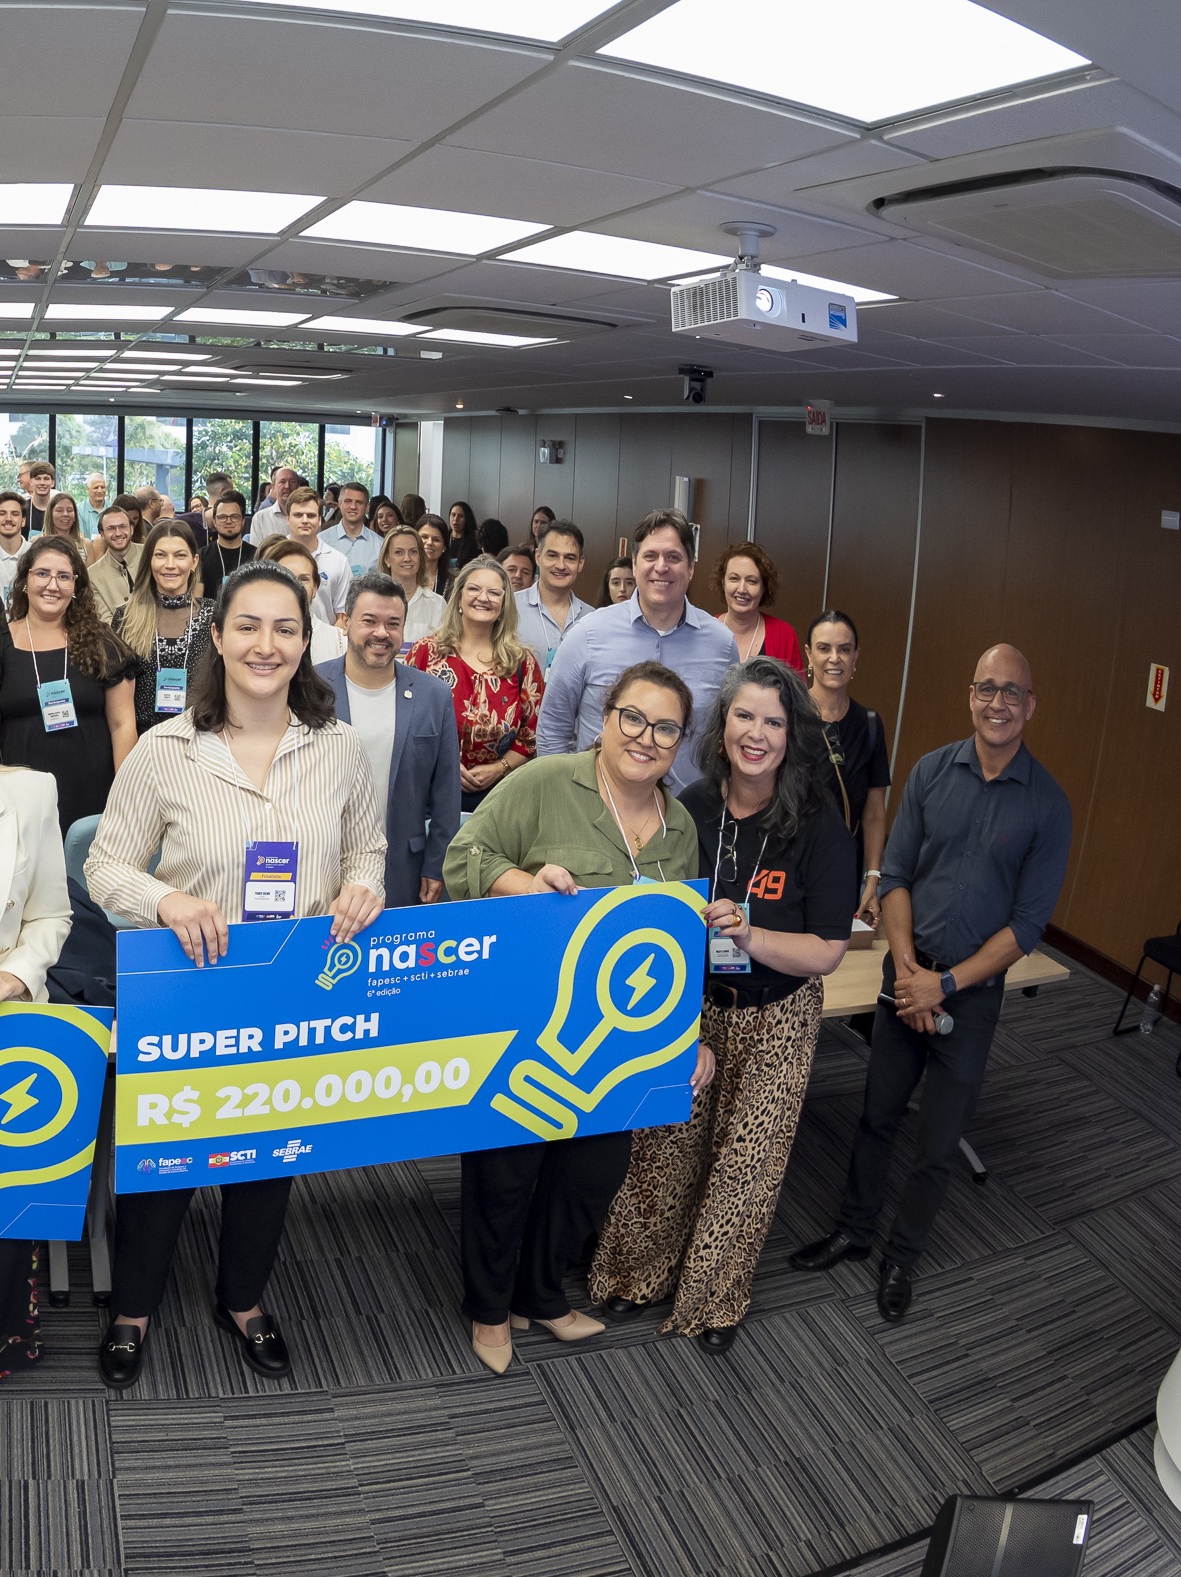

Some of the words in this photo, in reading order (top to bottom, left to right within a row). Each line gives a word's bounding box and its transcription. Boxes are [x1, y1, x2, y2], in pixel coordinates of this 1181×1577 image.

[747, 870, 786, 900] 49
[371, 930, 435, 946] programa
[369, 934, 497, 972] nascer
[367, 976, 401, 988] fapesc
[410, 971, 428, 981] scti
[437, 968, 469, 978] sebrae
[376, 987, 401, 997] edição
[137, 1027, 263, 1063] SUPER
[274, 1012, 379, 1050] PITCH
[137, 1086, 201, 1128] R$
[215, 1057, 471, 1120] 220.000,00
[159, 1156, 193, 1167] fapesc
[229, 1149, 256, 1161] SCTI
[272, 1145, 313, 1157] SEBRAE
